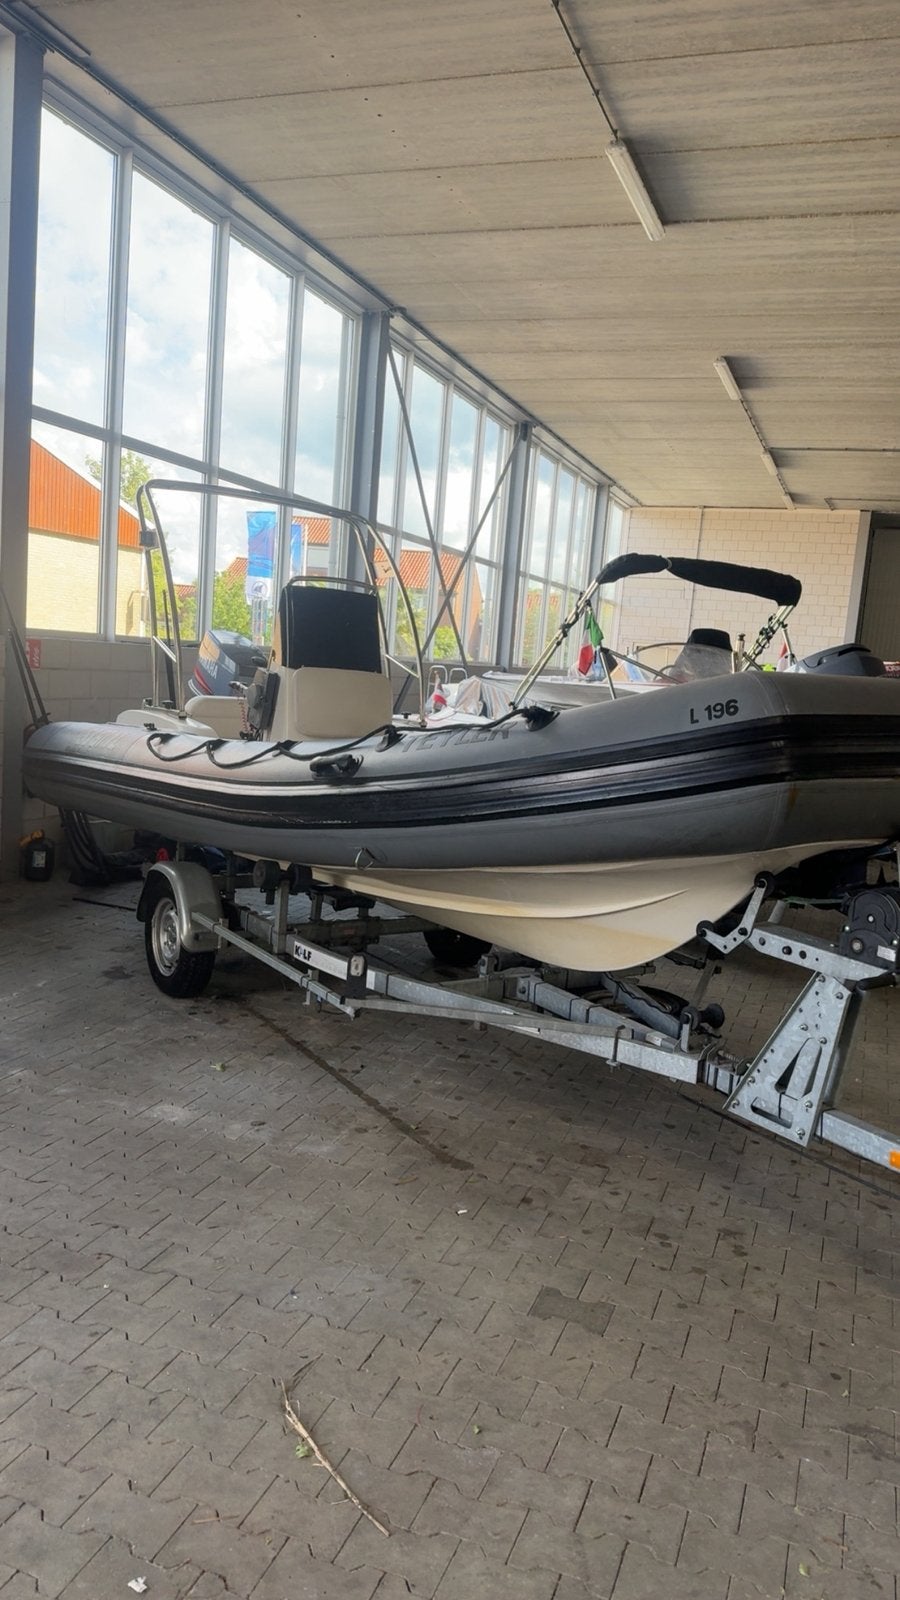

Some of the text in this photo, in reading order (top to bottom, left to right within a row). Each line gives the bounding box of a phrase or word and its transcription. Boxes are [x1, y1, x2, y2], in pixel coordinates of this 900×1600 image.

[690, 699, 739, 724] L 196
[295, 945, 312, 961] KLF
